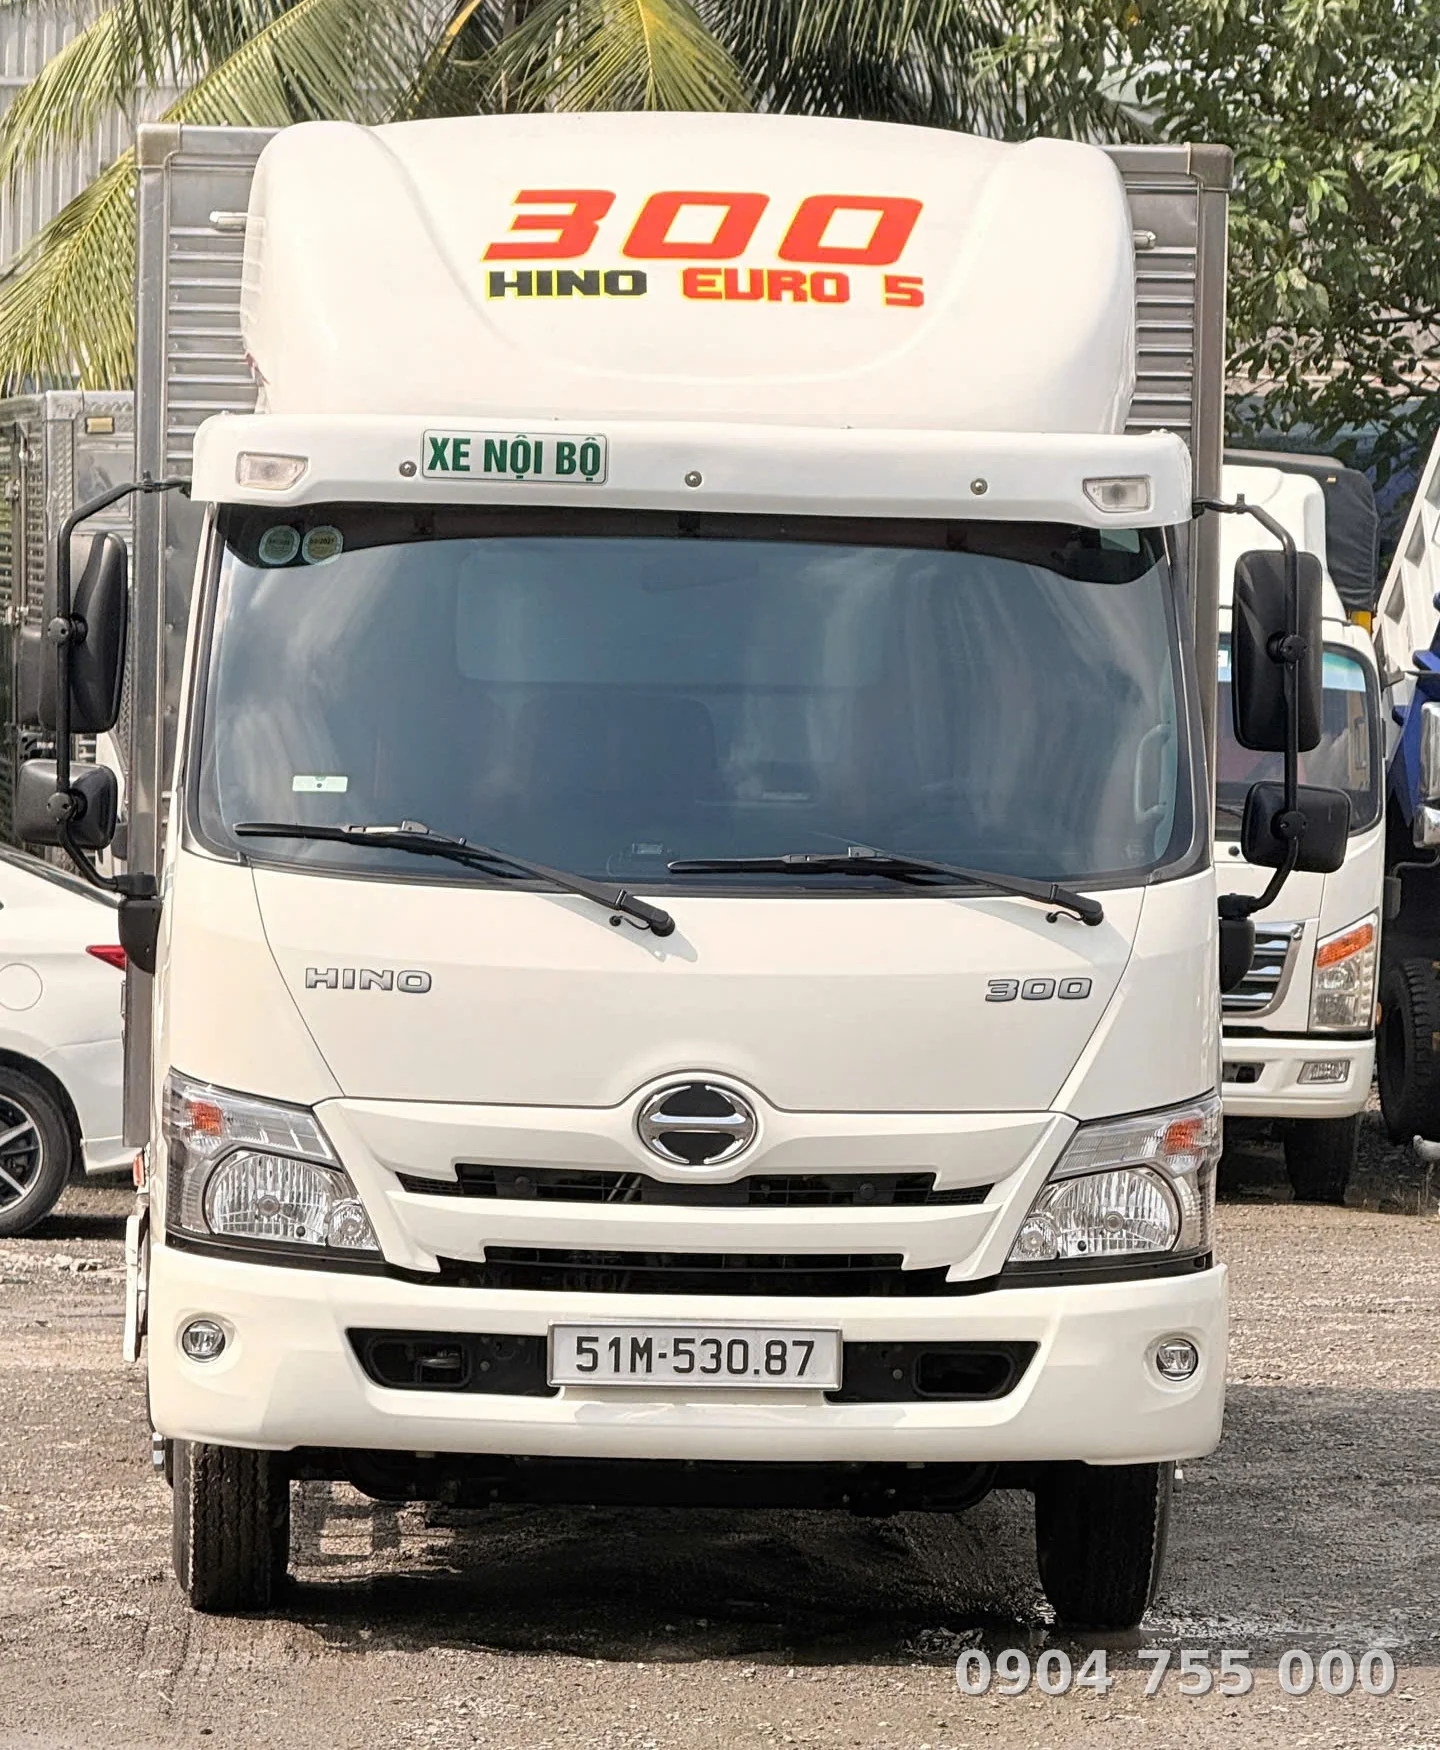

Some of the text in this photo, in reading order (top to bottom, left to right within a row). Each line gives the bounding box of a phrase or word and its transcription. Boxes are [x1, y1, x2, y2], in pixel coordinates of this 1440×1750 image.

[481, 189, 924, 265] 300
[486, 268, 924, 308] HINO EURO 5
[427, 435, 600, 481] XE NỘI BỘ
[305, 968, 432, 993] HINO
[985, 978, 1092, 1002] 300
[576, 1336, 815, 1376] 51M-530.87
